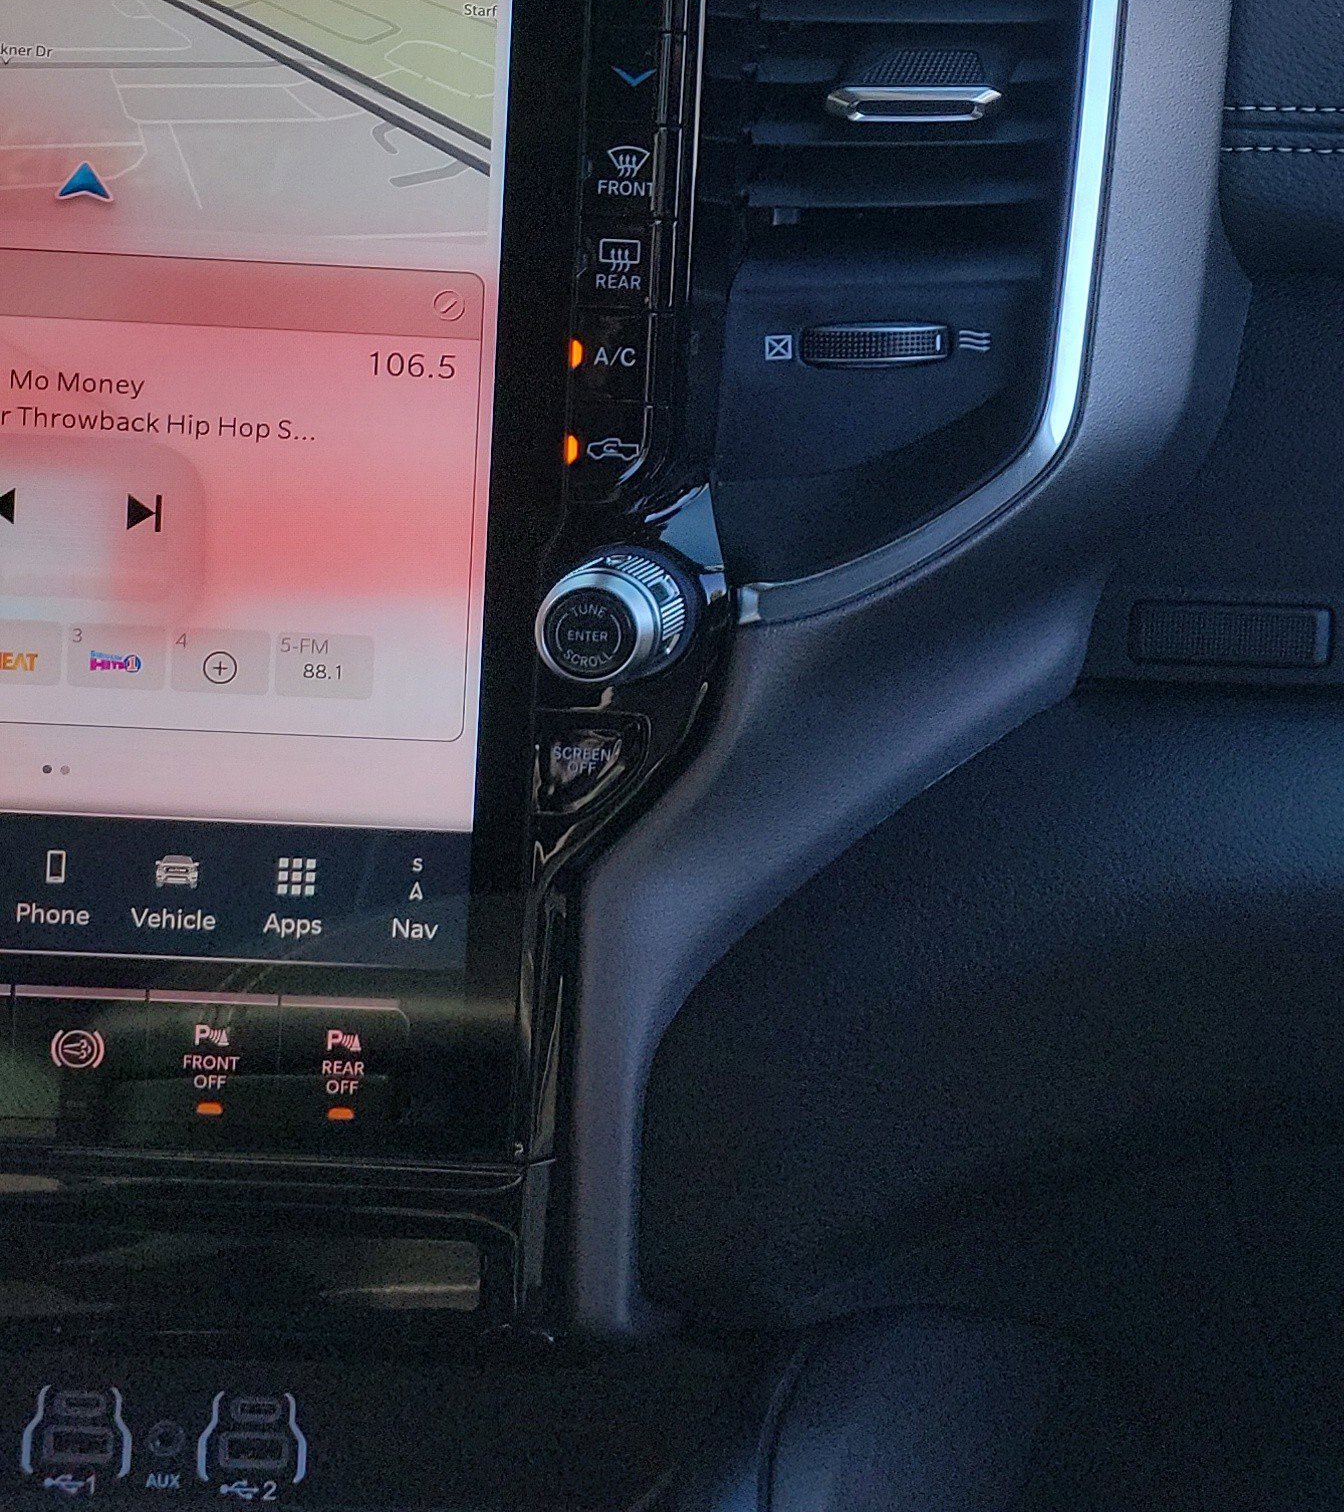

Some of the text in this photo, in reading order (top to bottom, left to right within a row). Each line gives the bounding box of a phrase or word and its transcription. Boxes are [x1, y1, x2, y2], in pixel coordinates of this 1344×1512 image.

[0, 43, 54, 57] kner Dr
[595, 273, 641, 289] REAR
[369, 351, 456, 379] 106.5
[593, 346, 636, 367] A/C
[10, 369, 145, 399] Mo Money
[17, 406, 159, 433] Throwback
[167, 414, 210, 439] Hip
[218, 417, 270, 442] Hop
[570, 603, 607, 619] TUNE
[72, 627, 83, 643] 3
[175, 632, 187, 648] 4
[567, 630, 608, 642] ENTER
[280, 638, 329, 654] 5-FM
[563, 648, 614, 668] SCROLL
[303, 663, 342, 680] 88.1
[553, 745, 612, 763] SCREEN
[567, 760, 598, 775] OFF
[16, 902, 90, 925] Phone
[130, 907, 216, 931] Vehicle
[262, 913, 323, 939] Apps
[391, 918, 439, 940] Nav
[182, 1054, 240, 1071] FRONT
[321, 1060, 365, 1076] REAR
[193, 1074, 227, 1090] OFF
[326, 1080, 359, 1095] OFF
[145, 1472, 181, 1489] AUX
[262, 1480, 277, 1501] 2
